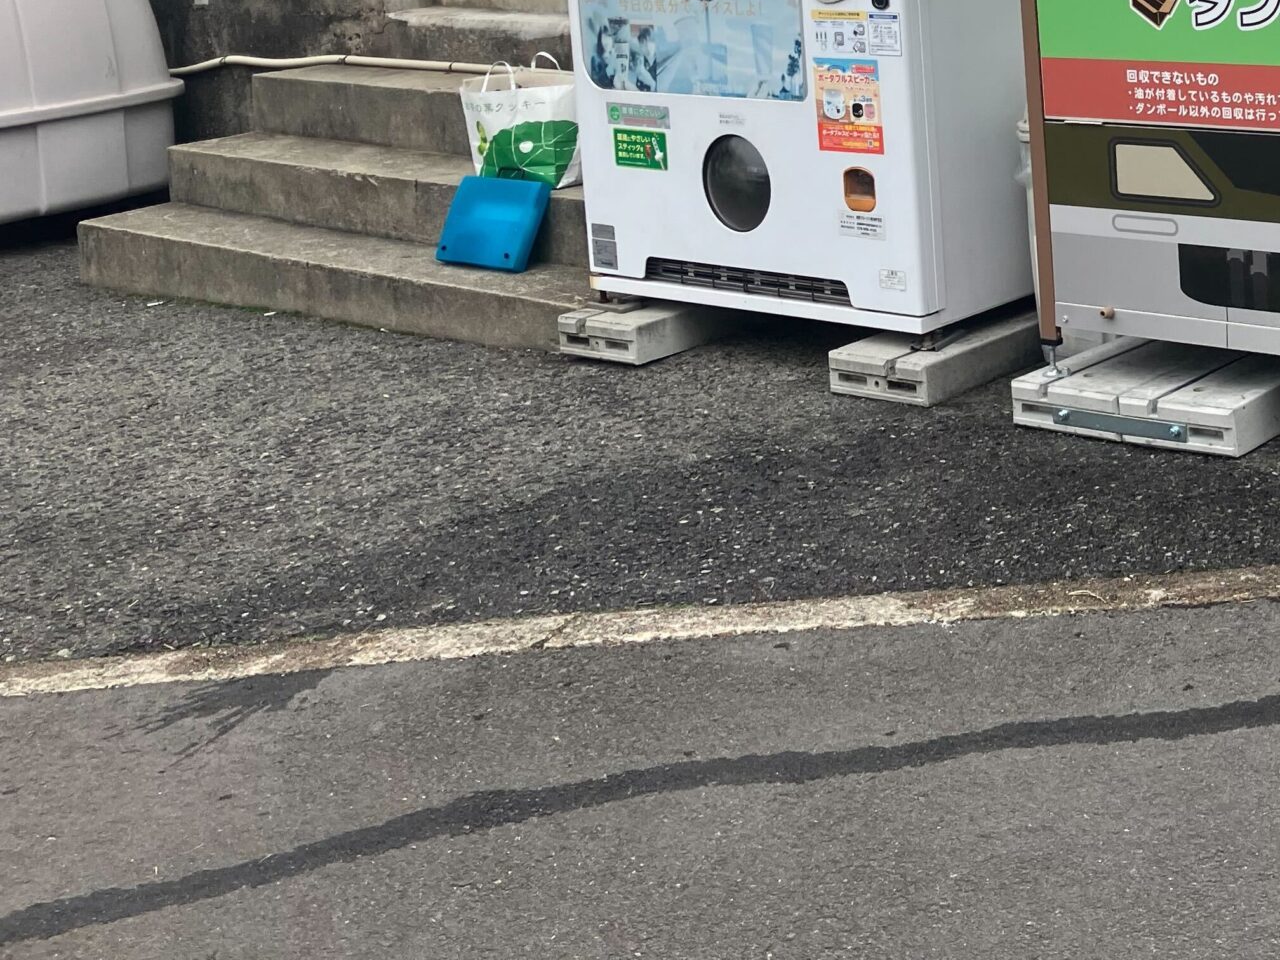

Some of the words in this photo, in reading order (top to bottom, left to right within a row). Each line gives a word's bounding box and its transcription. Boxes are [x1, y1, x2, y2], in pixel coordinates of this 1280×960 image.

[1126, 69, 1219, 87] 回収できないもの
